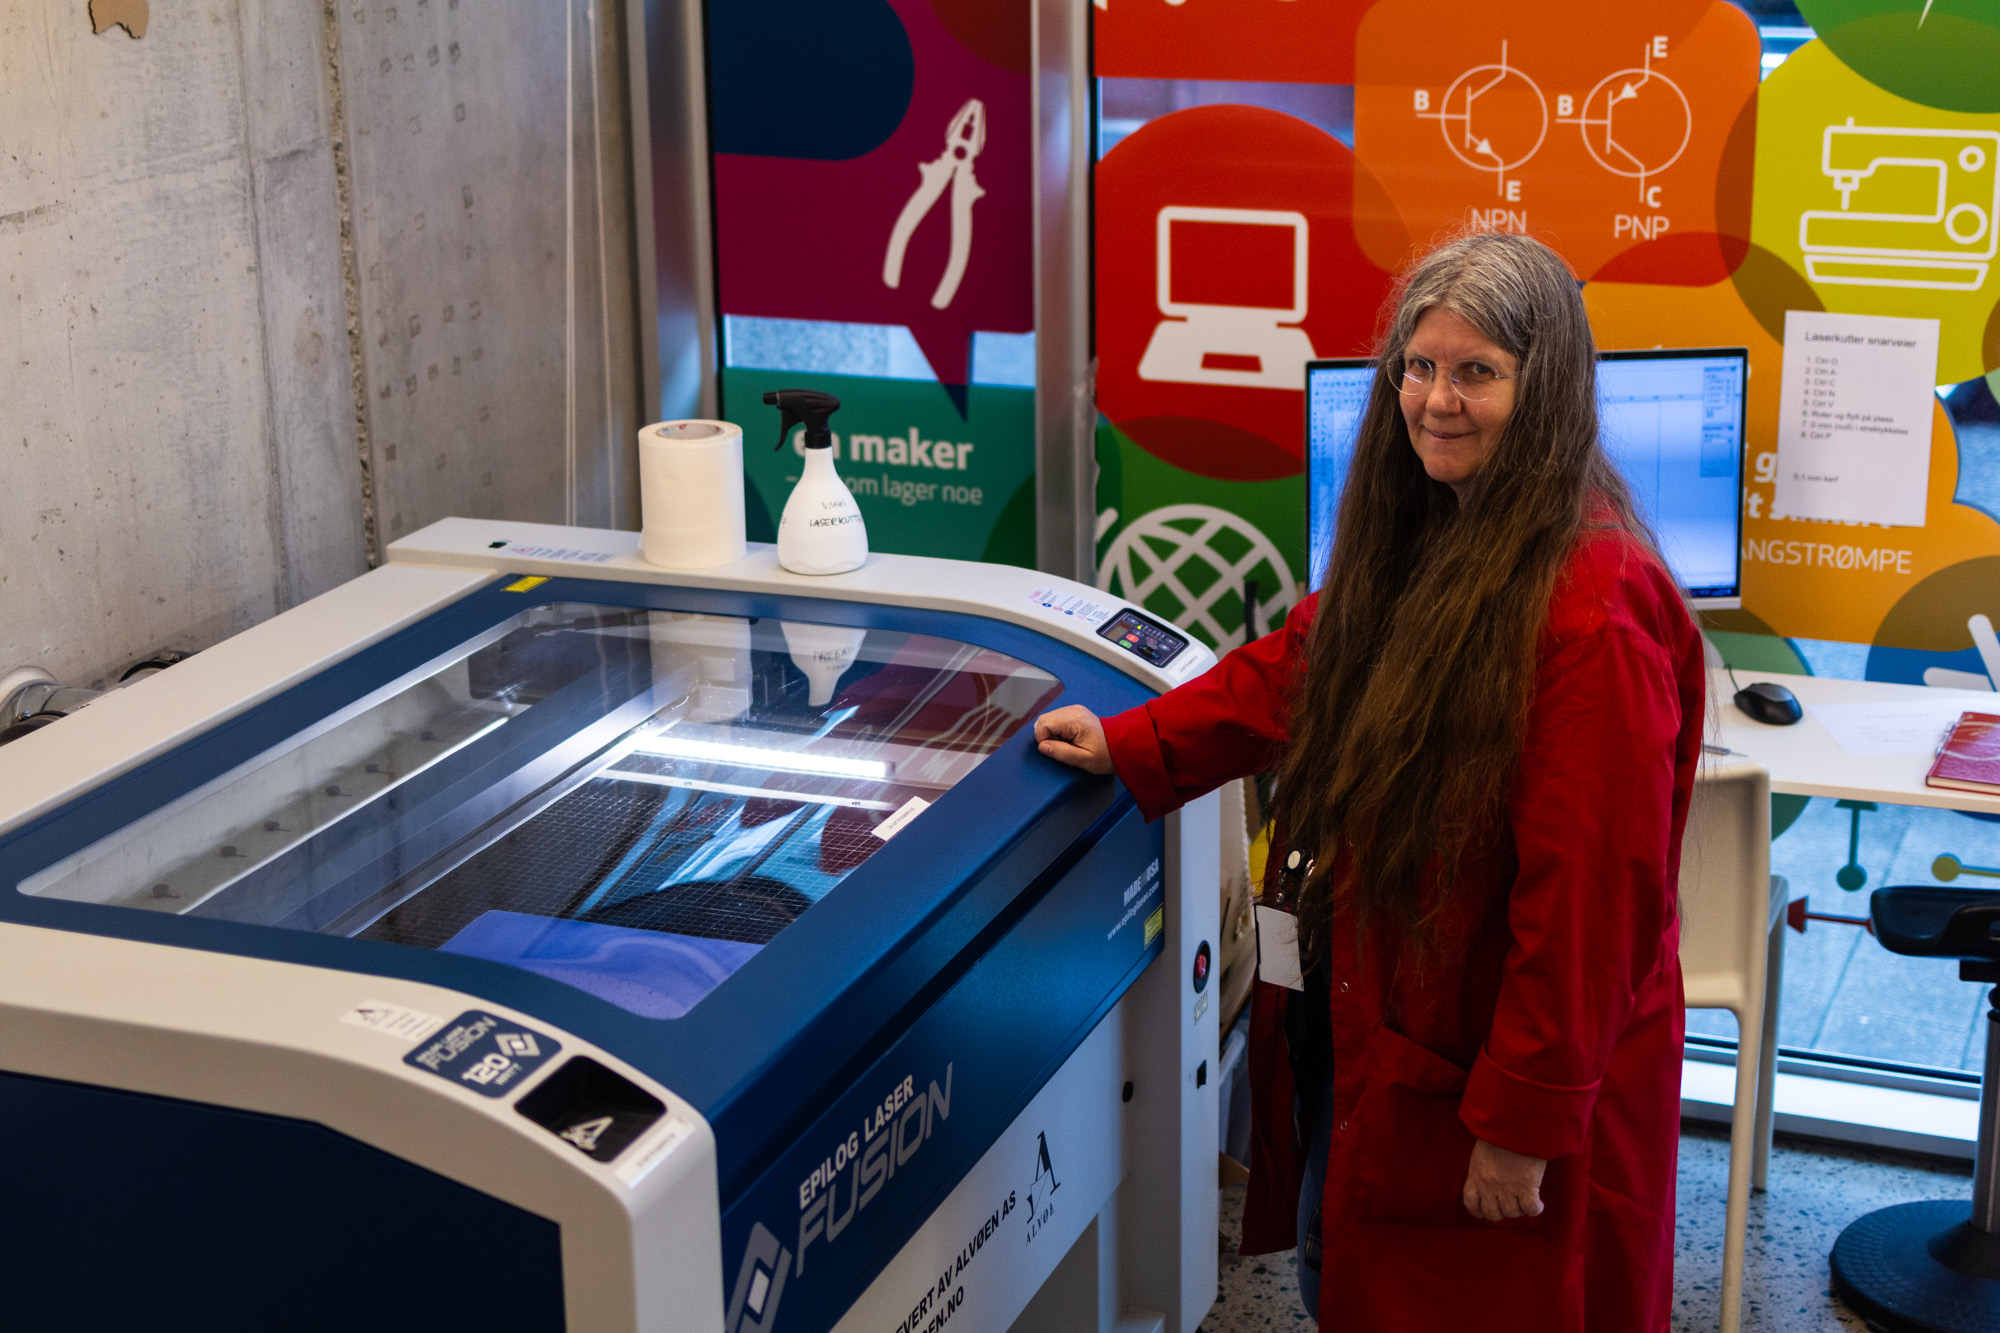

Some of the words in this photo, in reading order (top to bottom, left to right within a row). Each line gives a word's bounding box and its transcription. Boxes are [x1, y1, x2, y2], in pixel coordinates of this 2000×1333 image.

[1653, 37, 1668, 58] E
[1414, 90, 1430, 111] B
[1558, 95, 1574, 117] B
[1507, 181, 1521, 202] E
[1646, 186, 1662, 208] C
[1471, 208, 1527, 234] NPN
[1614, 214, 1670, 241] PNP
[1805, 331, 1865, 344] Laserkutter
[1868, 336, 1917, 348] snarveier
[851, 427, 973, 470] maker
[843, 475, 879, 496] om
[883, 474, 938, 507] lager
[942, 484, 984, 506] noe
[1123, 875, 1142, 907] MADE
[1146, 857, 1160, 882] USA
[461, 1052, 512, 1086] 120
[799, 1130, 860, 1211] EPILOG
[864, 1073, 915, 1144] LASER
[796, 1061, 954, 1280] FUSION
[937, 1264, 953, 1300] AV
[954, 1208, 1000, 1278] ALVØEN
[1001, 1189, 1017, 1222] AS
